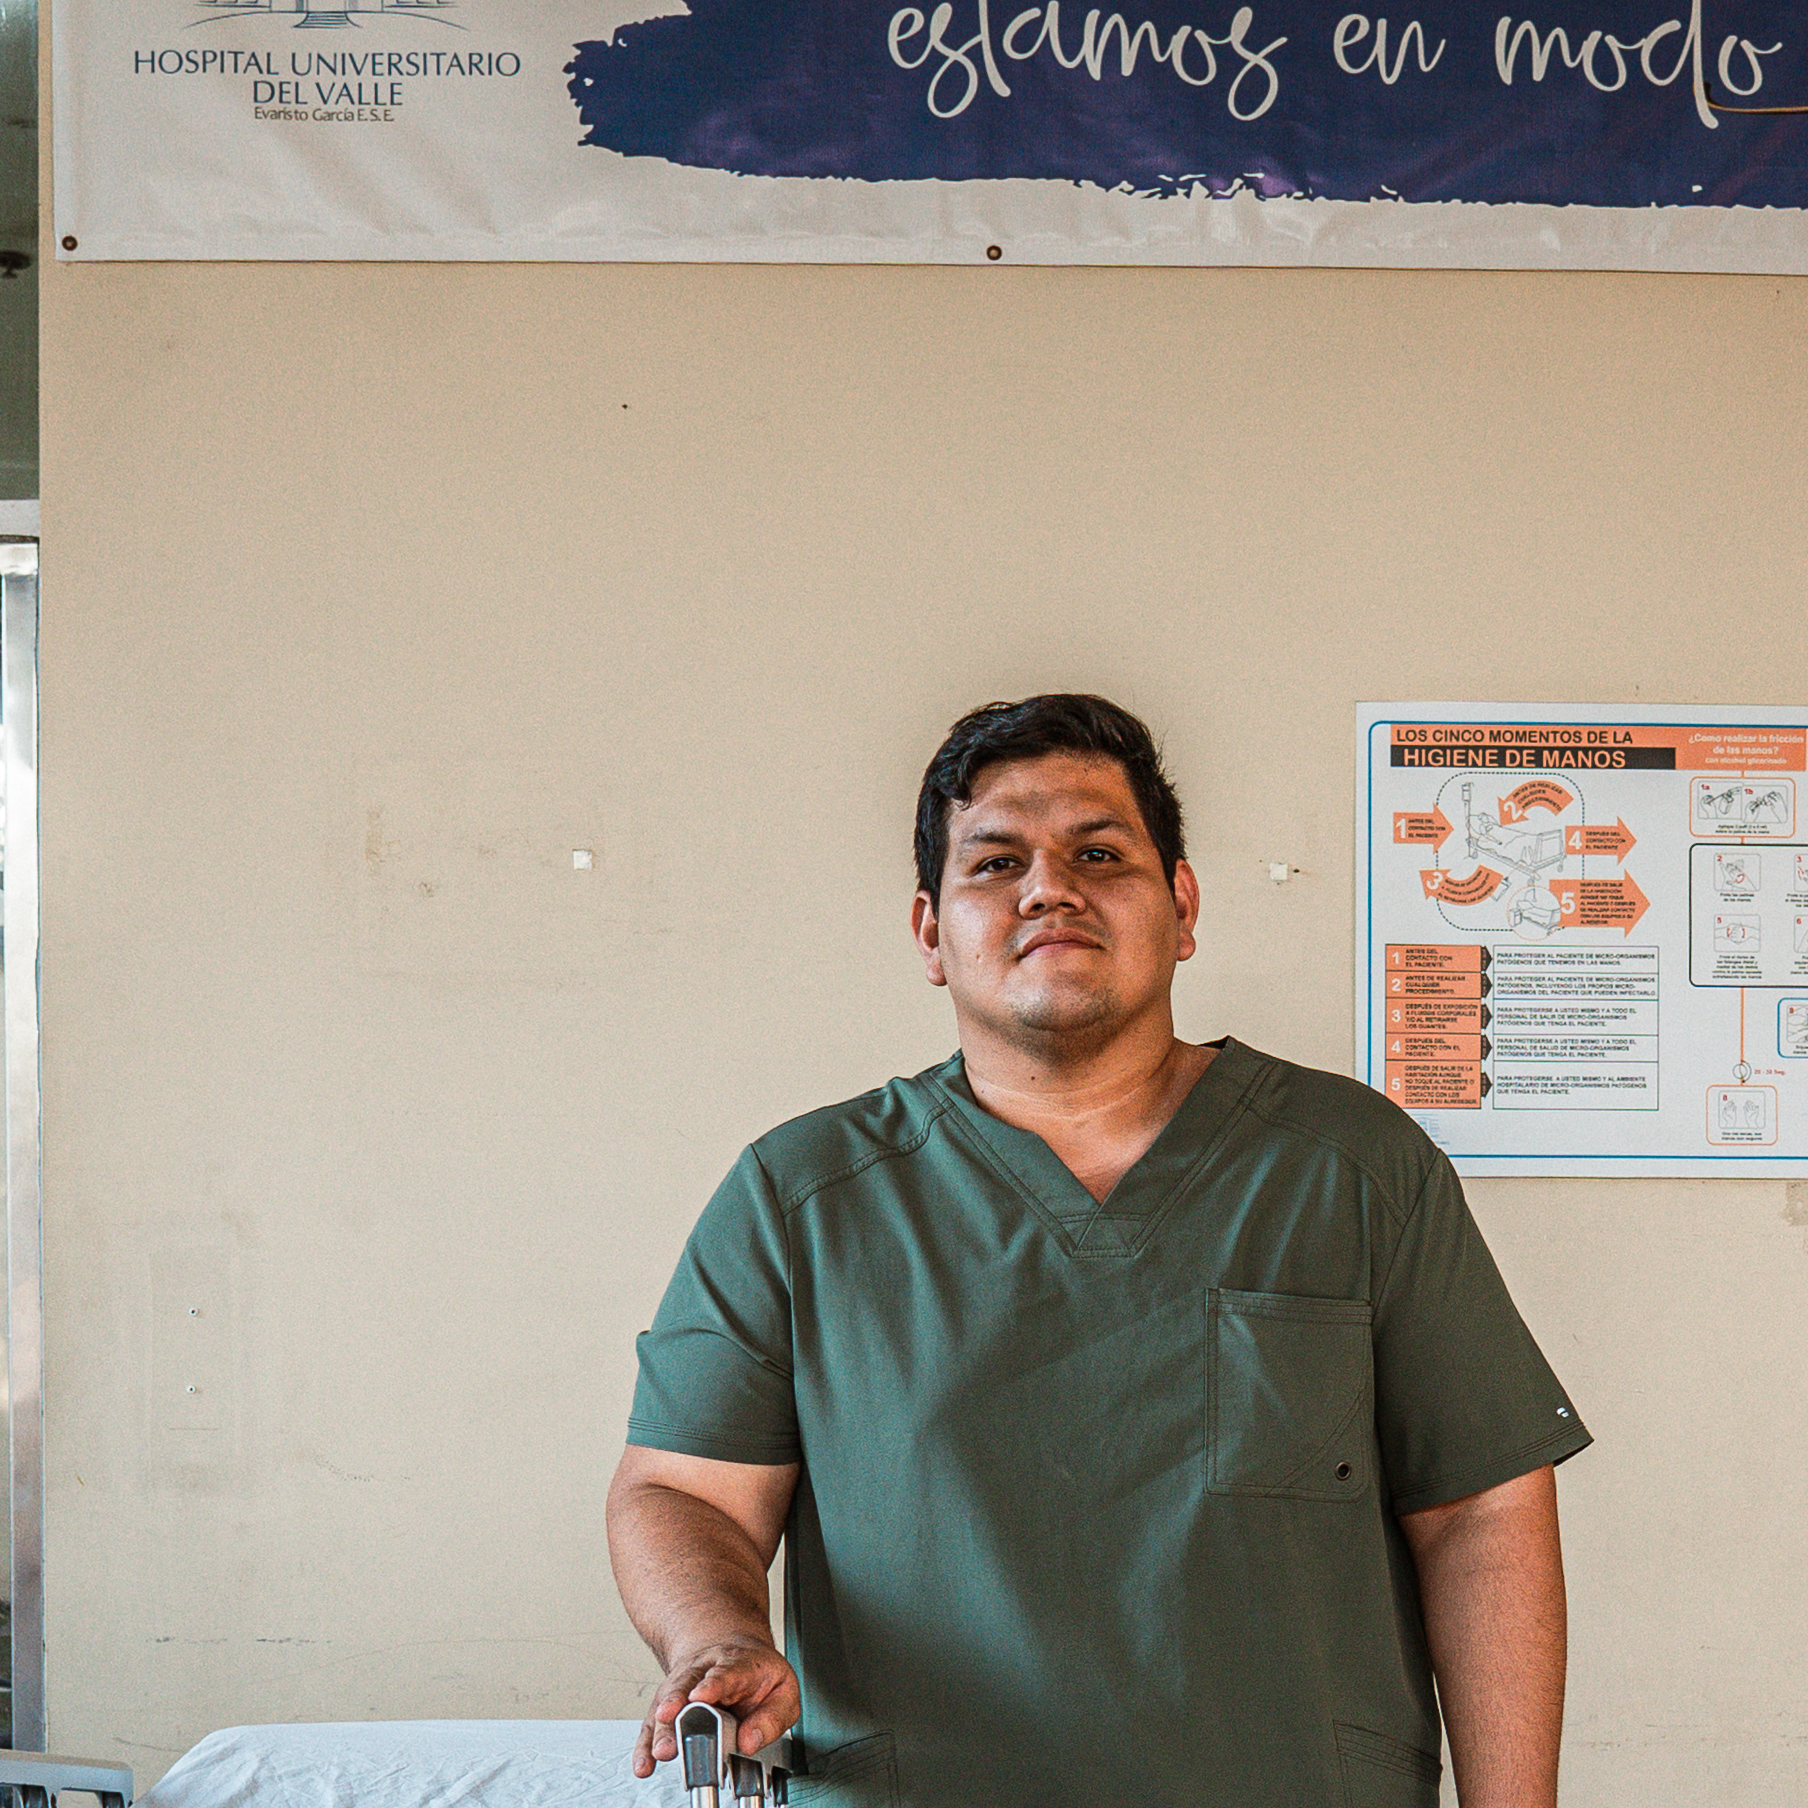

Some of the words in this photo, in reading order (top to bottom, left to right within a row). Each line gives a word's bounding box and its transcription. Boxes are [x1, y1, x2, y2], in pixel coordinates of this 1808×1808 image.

[134, 50, 279, 76] HOSPITAL
[291, 52, 522, 78] UNIVERSITARIO
[1333, 13, 1445, 85] en
[1495, 0, 1783, 128] modo
[253, 80, 308, 105] DEL
[316, 82, 404, 106] VALLE
[254, 106, 310, 121] Evaristo
[312, 107, 356, 122] García
[1396, 730, 1427, 742] LOS
[1432, 730, 1485, 743] CINCO
[1489, 730, 1583, 744] MOMENTOS
[1587, 731, 1609, 744] DE
[1613, 731, 1633, 745] LA
[1723, 734, 1757, 744] realizar
[1759, 735, 1768, 744] la
[1769, 735, 1805, 745] fricción
[1403, 749, 1499, 767] HIGIENE
[1505, 750, 1537, 767] DE
[1543, 750, 1626, 768] MANOS
[1713, 745, 1726, 754] de
[1727, 745, 1741, 754] las
[1742, 746, 1780, 755] manos?
[1503, 801, 1524, 821] 2
[1396, 818, 1407, 839] 1
[1568, 830, 1583, 850] 4
[1426, 871, 1444, 890] 3
[1561, 892, 1576, 914] 5
[1391, 951, 1400, 964] 1
[1391, 978, 1401, 991] 2
[1391, 1009, 1401, 1022] 3
[1391, 1040, 1401, 1053] 4
[1391, 1078, 1401, 1091] 5
